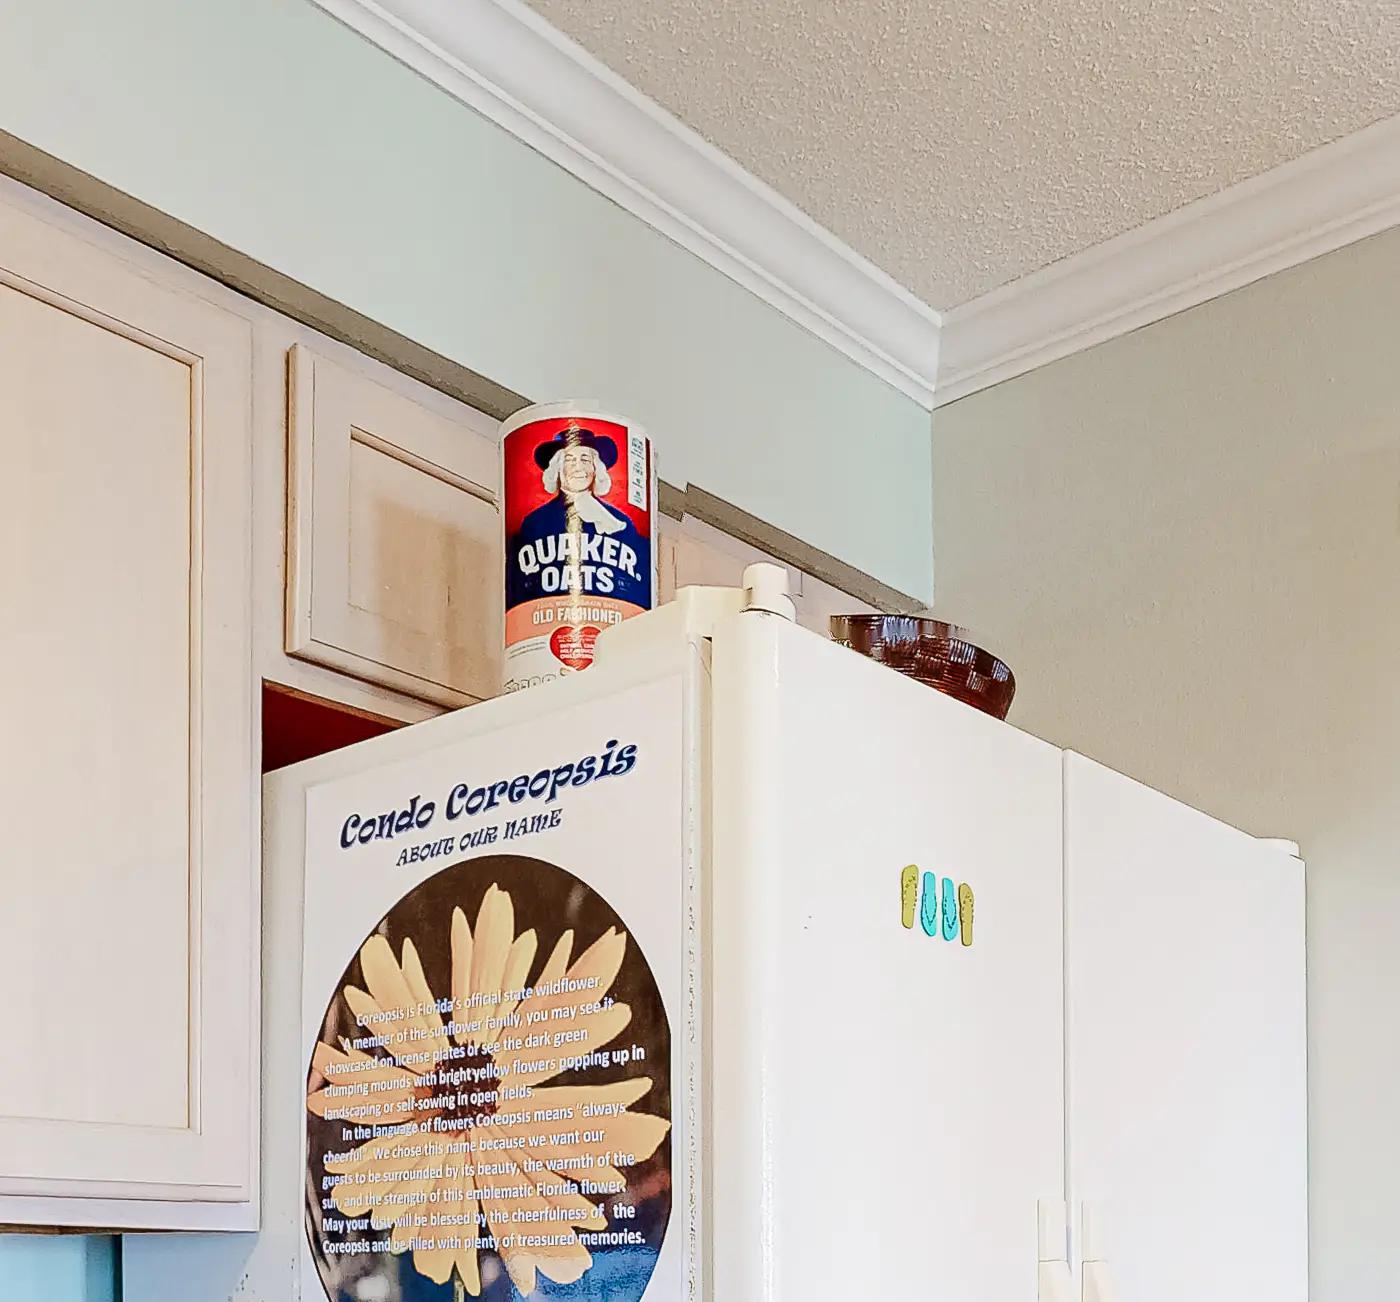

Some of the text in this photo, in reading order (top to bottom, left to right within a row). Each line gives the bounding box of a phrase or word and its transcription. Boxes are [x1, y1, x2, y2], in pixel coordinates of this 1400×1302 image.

[541, 565, 614, 593] OATS
[533, 607, 622, 625] OLD FAHIONED
[340, 739, 638, 849] Condo Coreopsis
[396, 836, 455, 866] ABOUT
[459, 826, 499, 851] OUR
[356, 1007, 404, 1027] Coreopsis
[417, 997, 462, 1015] Florida's
[464, 989, 501, 1009] official
[504, 986, 533, 1002] state
[535, 975, 603, 997] wildflower.
[343, 1040, 351, 1051] A
[352, 1033, 395, 1050] member
[397, 1030, 408, 1043] of
[410, 1027, 427, 1041] the
[429, 1018, 482, 1038] sunflower
[526, 1011, 548, 1026] you
[551, 1006, 577, 1022] may
[579, 1002, 601, 1015] see
[602, 996, 614, 1010] it
[325, 1029, 588, 1075] showcased on license plates or see the dark green
[324, 1044, 645, 1097] clumping mounds with bright yellow flowers popping up in
[323, 1102, 381, 1121] landscaping
[383, 1102, 395, 1113] or
[396, 1093, 456, 1112] self-sowing
[457, 1091, 468, 1105] in
[470, 1090, 499, 1107] open
[342, 1127, 353, 1142] In
[354, 1125, 371, 1140] the
[372, 1120, 419, 1138] language
[420, 1118, 432, 1132] of
[433, 1115, 474, 1132] flowers
[475, 1108, 531, 1127] Coreopsis
[533, 1106, 573, 1122] means
[373, 1147, 391, 1160] We
[391, 1144, 422, 1159] chose
[424, 1141, 444, 1156] this
[446, 1140, 477, 1154] name
[479, 1134, 525, 1151] because
[528, 1135, 546, 1147] we
[549, 1130, 580, 1145] want
[583, 1130, 605, 1142] our
[322, 1150, 635, 1190] guests to be surrounded by its beauty, the warmth of the
[344, 1193, 363, 1207] and
[365, 1191, 381, 1206] the
[383, 1190, 427, 1207] strength
[429, 1188, 441, 1202] of
[443, 1187, 463, 1202] this
[466, 1182, 533, 1201] emblematic
[536, 1181, 579, 1197] Florida
[322, 1217, 344, 1234] May
[345, 1218, 369, 1233] your
[394, 1213, 412, 1228] will
[414, 1211, 427, 1226] be
[430, 1210, 470, 1226] blessed
[473, 1212, 487, 1228] by
[490, 1208, 509, 1223] the
[511, 1205, 587, 1222] cheerfulness
[590, 1203, 604, 1218] of
[612, 1203, 635, 1218] the
[322, 1228, 646, 1256] Coreopsis and be filled with plenty of treasured memories.
